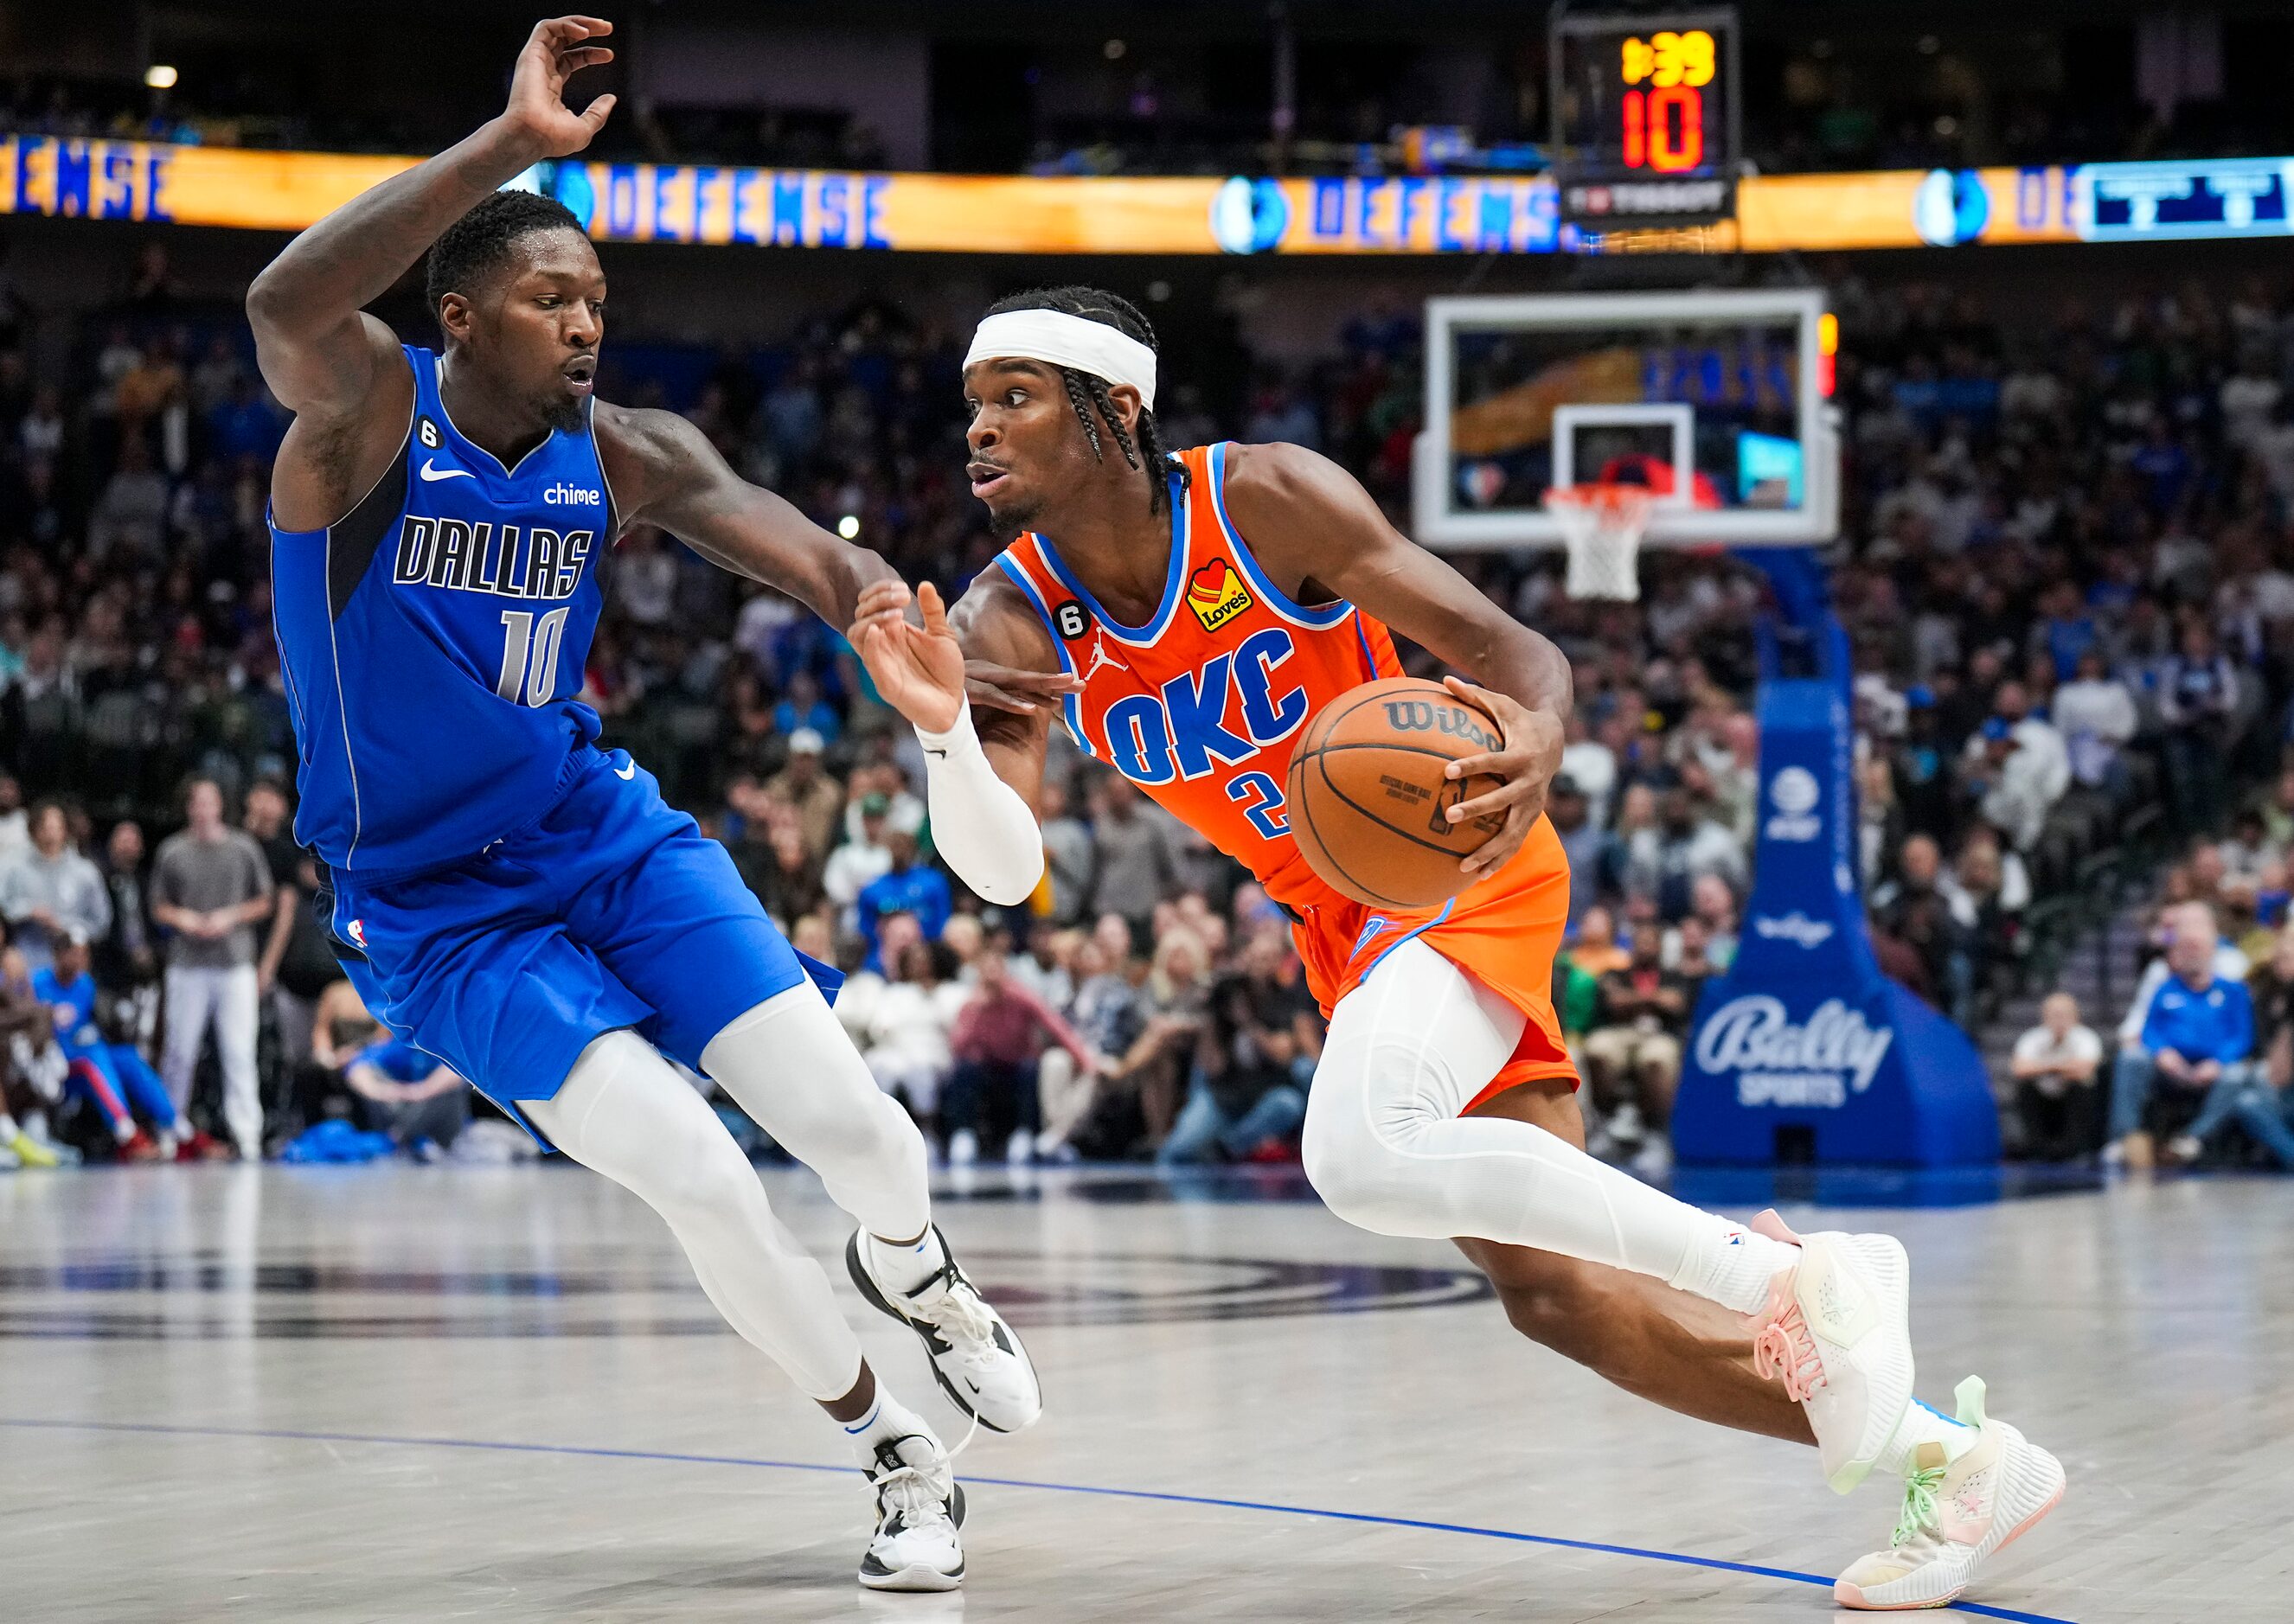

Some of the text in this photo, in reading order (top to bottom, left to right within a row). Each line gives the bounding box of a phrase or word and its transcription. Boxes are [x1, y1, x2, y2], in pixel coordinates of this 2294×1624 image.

[1622, 30, 1715, 87] 1:39
[1623, 85, 1703, 174] 10
[0, 135, 173, 222] ENSE
[607, 165, 891, 249] DEFENSE
[1311, 176, 1564, 253] DEFENS
[421, 419, 438, 448] 6
[544, 483, 599, 506] chime
[393, 515, 594, 599] DALLAS
[497, 606, 570, 708] 10
[1060, 605, 1083, 636] 6
[1103, 628, 1310, 785] OKC
[1382, 701, 1505, 752] Wilso
[1224, 770, 1292, 841] 2
[1696, 994, 1894, 1093] Bally
